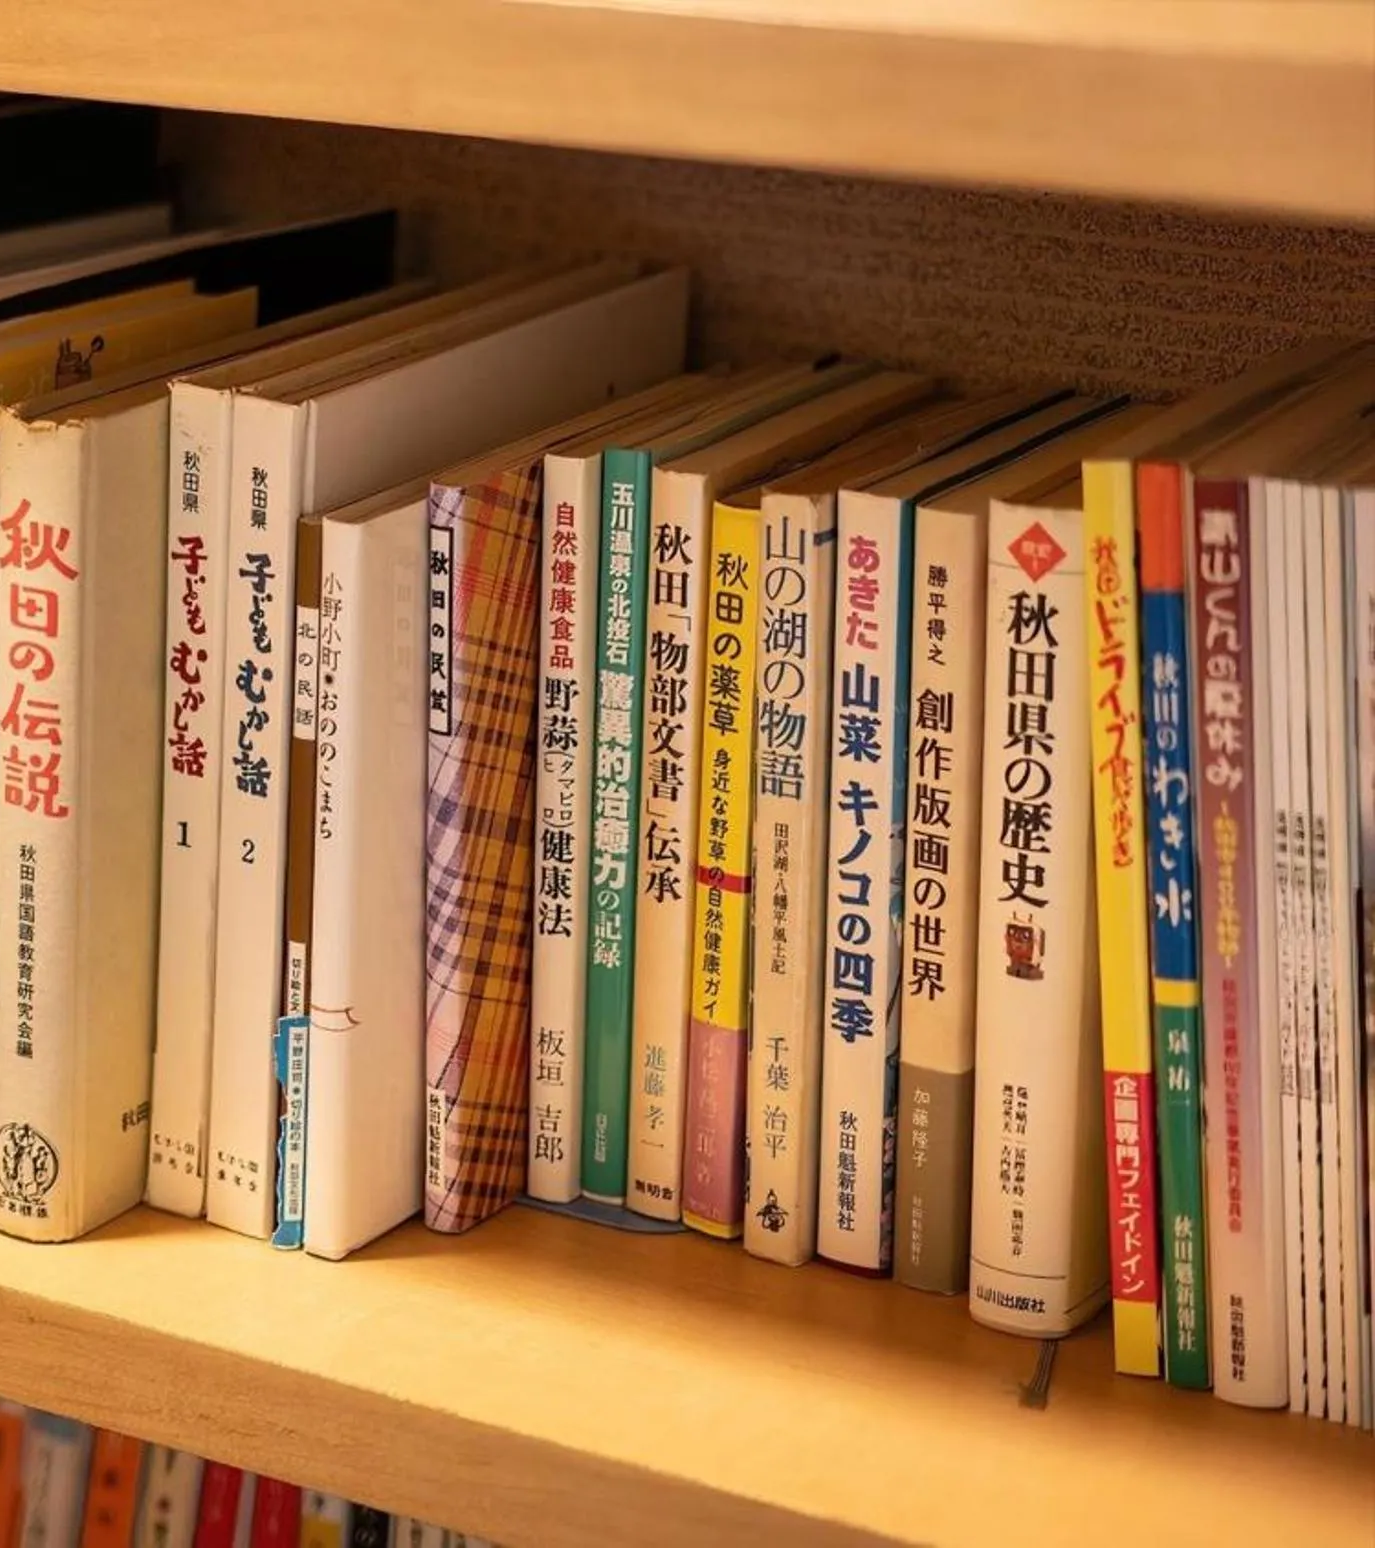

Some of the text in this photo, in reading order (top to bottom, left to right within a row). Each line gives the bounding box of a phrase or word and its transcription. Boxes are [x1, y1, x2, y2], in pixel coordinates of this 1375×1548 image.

[182, 450, 200, 513] 秋田県
[250, 466, 268, 531] 秋田県
[549, 501, 578, 669] 自然健康食品
[709, 552, 749, 735] 秋田の薬草
[760, 516, 807, 801] 山の湖の物語
[296, 623, 316, 725] 北の民話
[593, 482, 635, 969] 玉川温泉の北投石 驚異的治癒力の記録
[645, 522, 693, 903] 秋田「物部文書」伝承
[998, 589, 1060, 908] 秋田県の歴史
[176, 821, 192, 848] 1
[241, 839, 256, 864] 2
[831, 535, 882, 1043] あきた 山菜 キノコの四季
[908, 565, 954, 1001] 勝平得之 創作版画の世界
[1153, 652, 1192, 927] 秋田のわき水
[16, 843, 36, 1060] 秋田県国語教育研究会編
[538, 828, 575, 938] 健康法
[702, 747, 732, 1026] 身近な野草の自然健康ガイ
[535, 1026, 566, 1165] 板垣 吉郎
[837, 1110, 859, 1232] 秋田魁新報社
[1113, 1075, 1144, 1294] 企画専門フェイドイン
[976, 1284, 1046, 1314] 山川出版社
[1174, 1214, 1196, 1351] 秋田魁新報社
